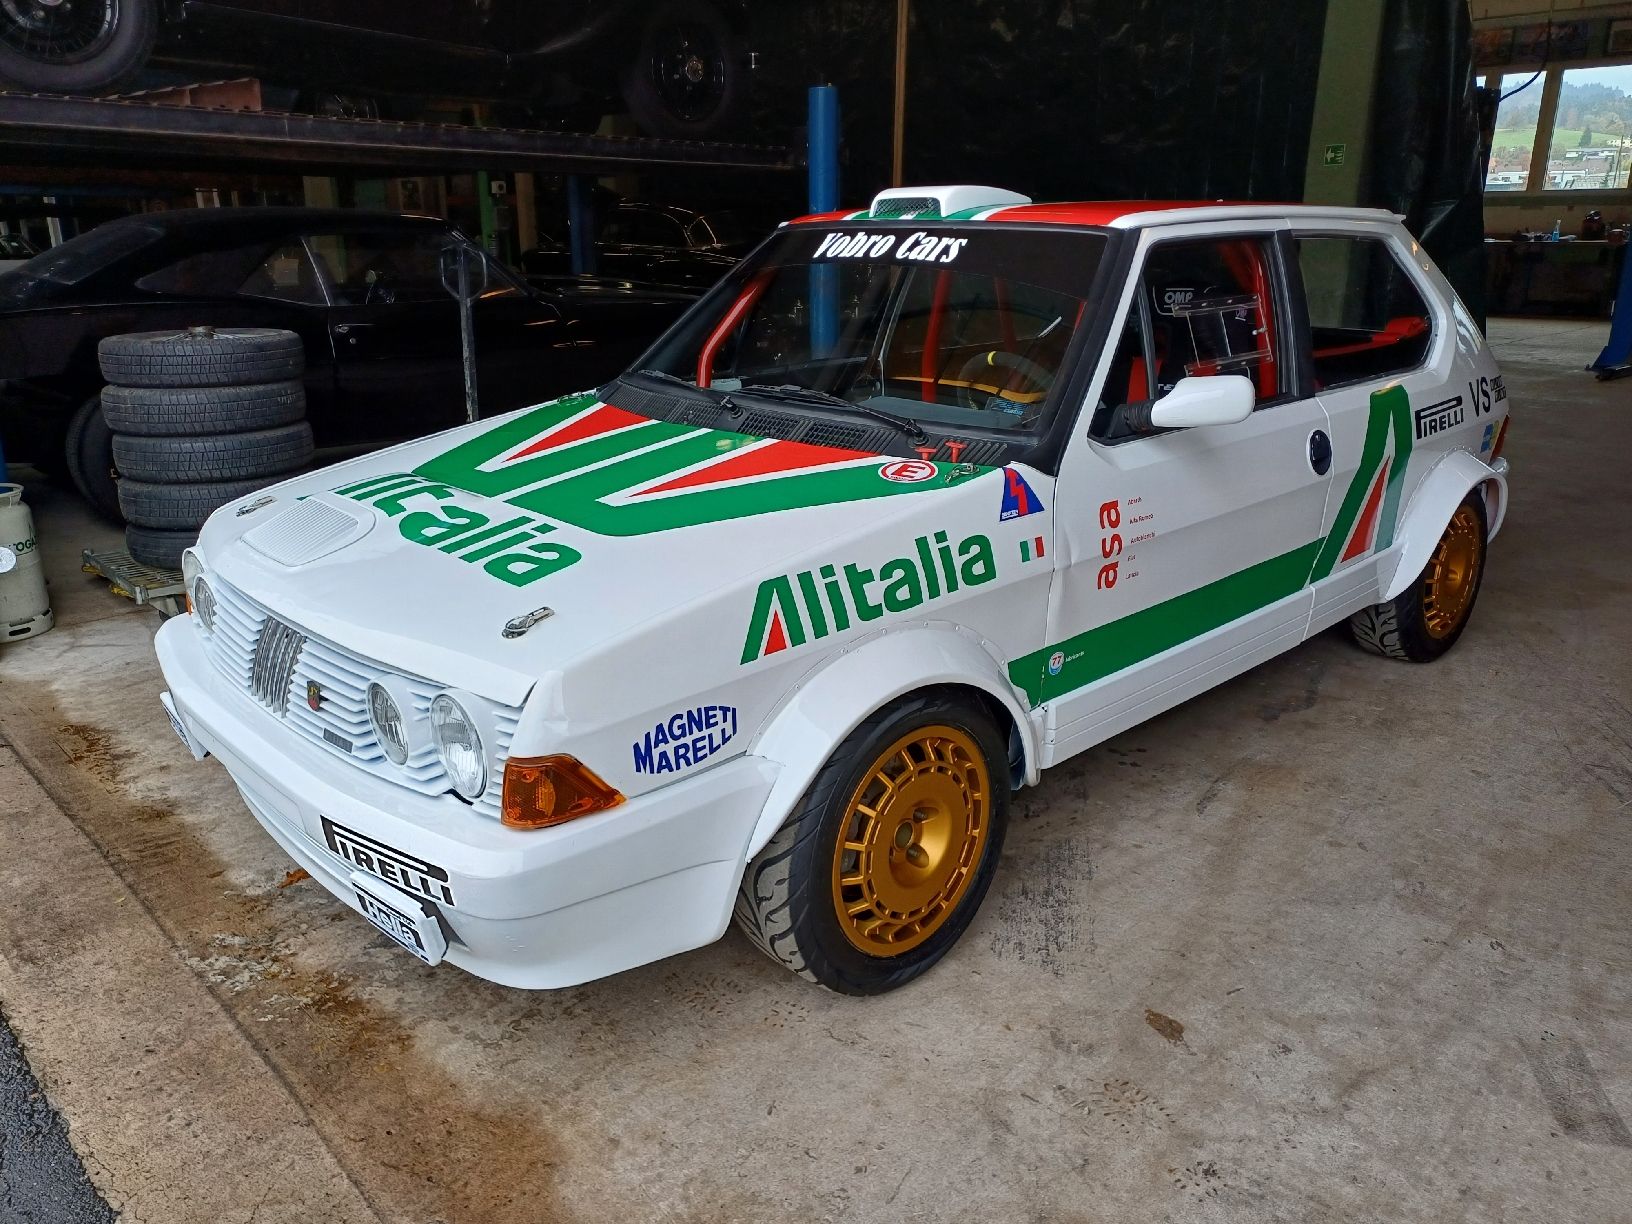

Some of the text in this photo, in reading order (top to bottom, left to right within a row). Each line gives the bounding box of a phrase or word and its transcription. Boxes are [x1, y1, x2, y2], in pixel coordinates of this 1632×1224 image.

[813, 232, 968, 262] Vobro Cars
[1164, 292, 1193, 304] OMP
[1415, 395, 1465, 440] PIRELLI
[1469, 376, 1491, 417] VS
[890, 463, 926, 479] E
[297, 473, 583, 587] litalia
[1098, 500, 1122, 590] asa
[740, 530, 997, 665] Alitalia
[1052, 655, 1063, 667] 77
[633, 705, 737, 774] MAGNETI
[633, 727, 737, 774] MARELLI
[320, 814, 455, 907] PIRELLI
[366, 899, 417, 942] Hella
